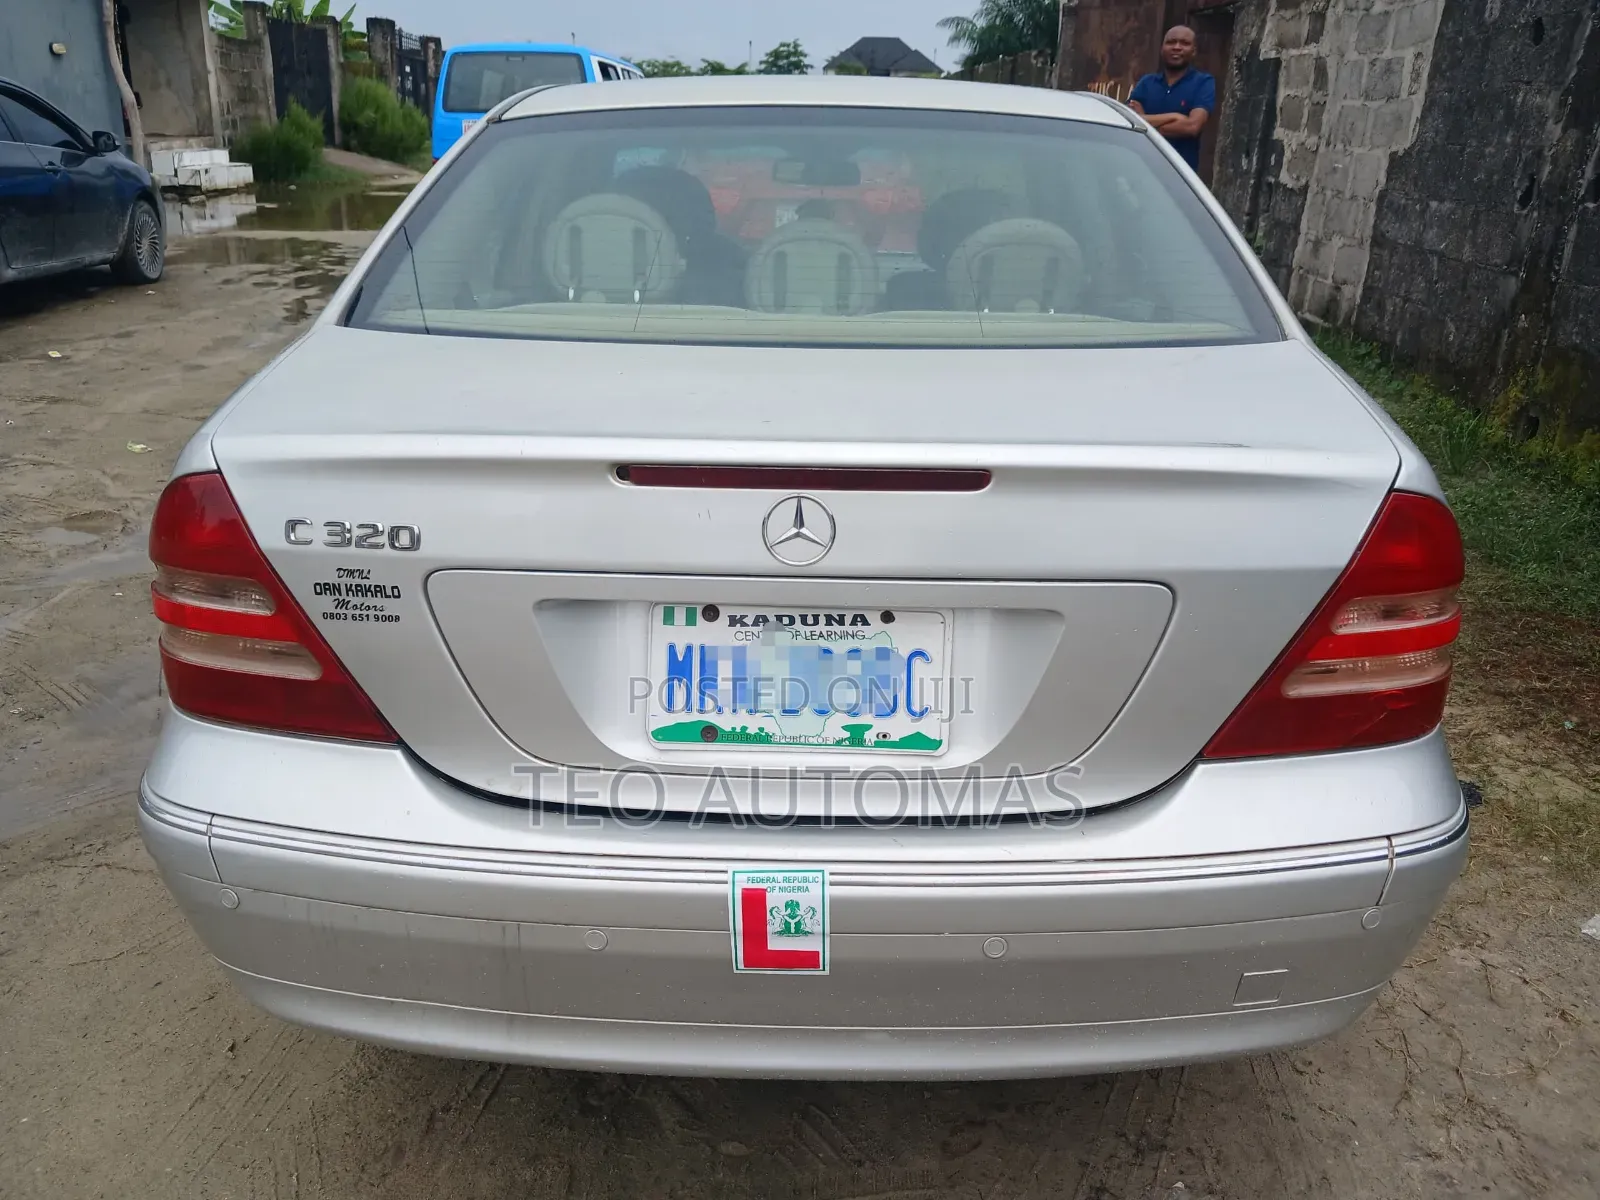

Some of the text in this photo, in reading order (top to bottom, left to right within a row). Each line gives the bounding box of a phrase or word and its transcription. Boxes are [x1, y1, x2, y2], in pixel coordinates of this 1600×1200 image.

[284, 517, 421, 551] C 320
[314, 582, 401, 599] DAN KAKALO
[332, 598, 385, 612] Motors
[322, 612, 401, 623] 0803 651 9008
[728, 613, 871, 627] KADUNA
[734, 630, 770, 641] CEN
[804, 630, 866, 642] LEARNING
[721, 733, 874, 746] FEDERAL REPUBLIC OF NIGERIA
[747, 876, 819, 884] FEDERAL REPUBLIC
[742, 888, 820, 968] L
